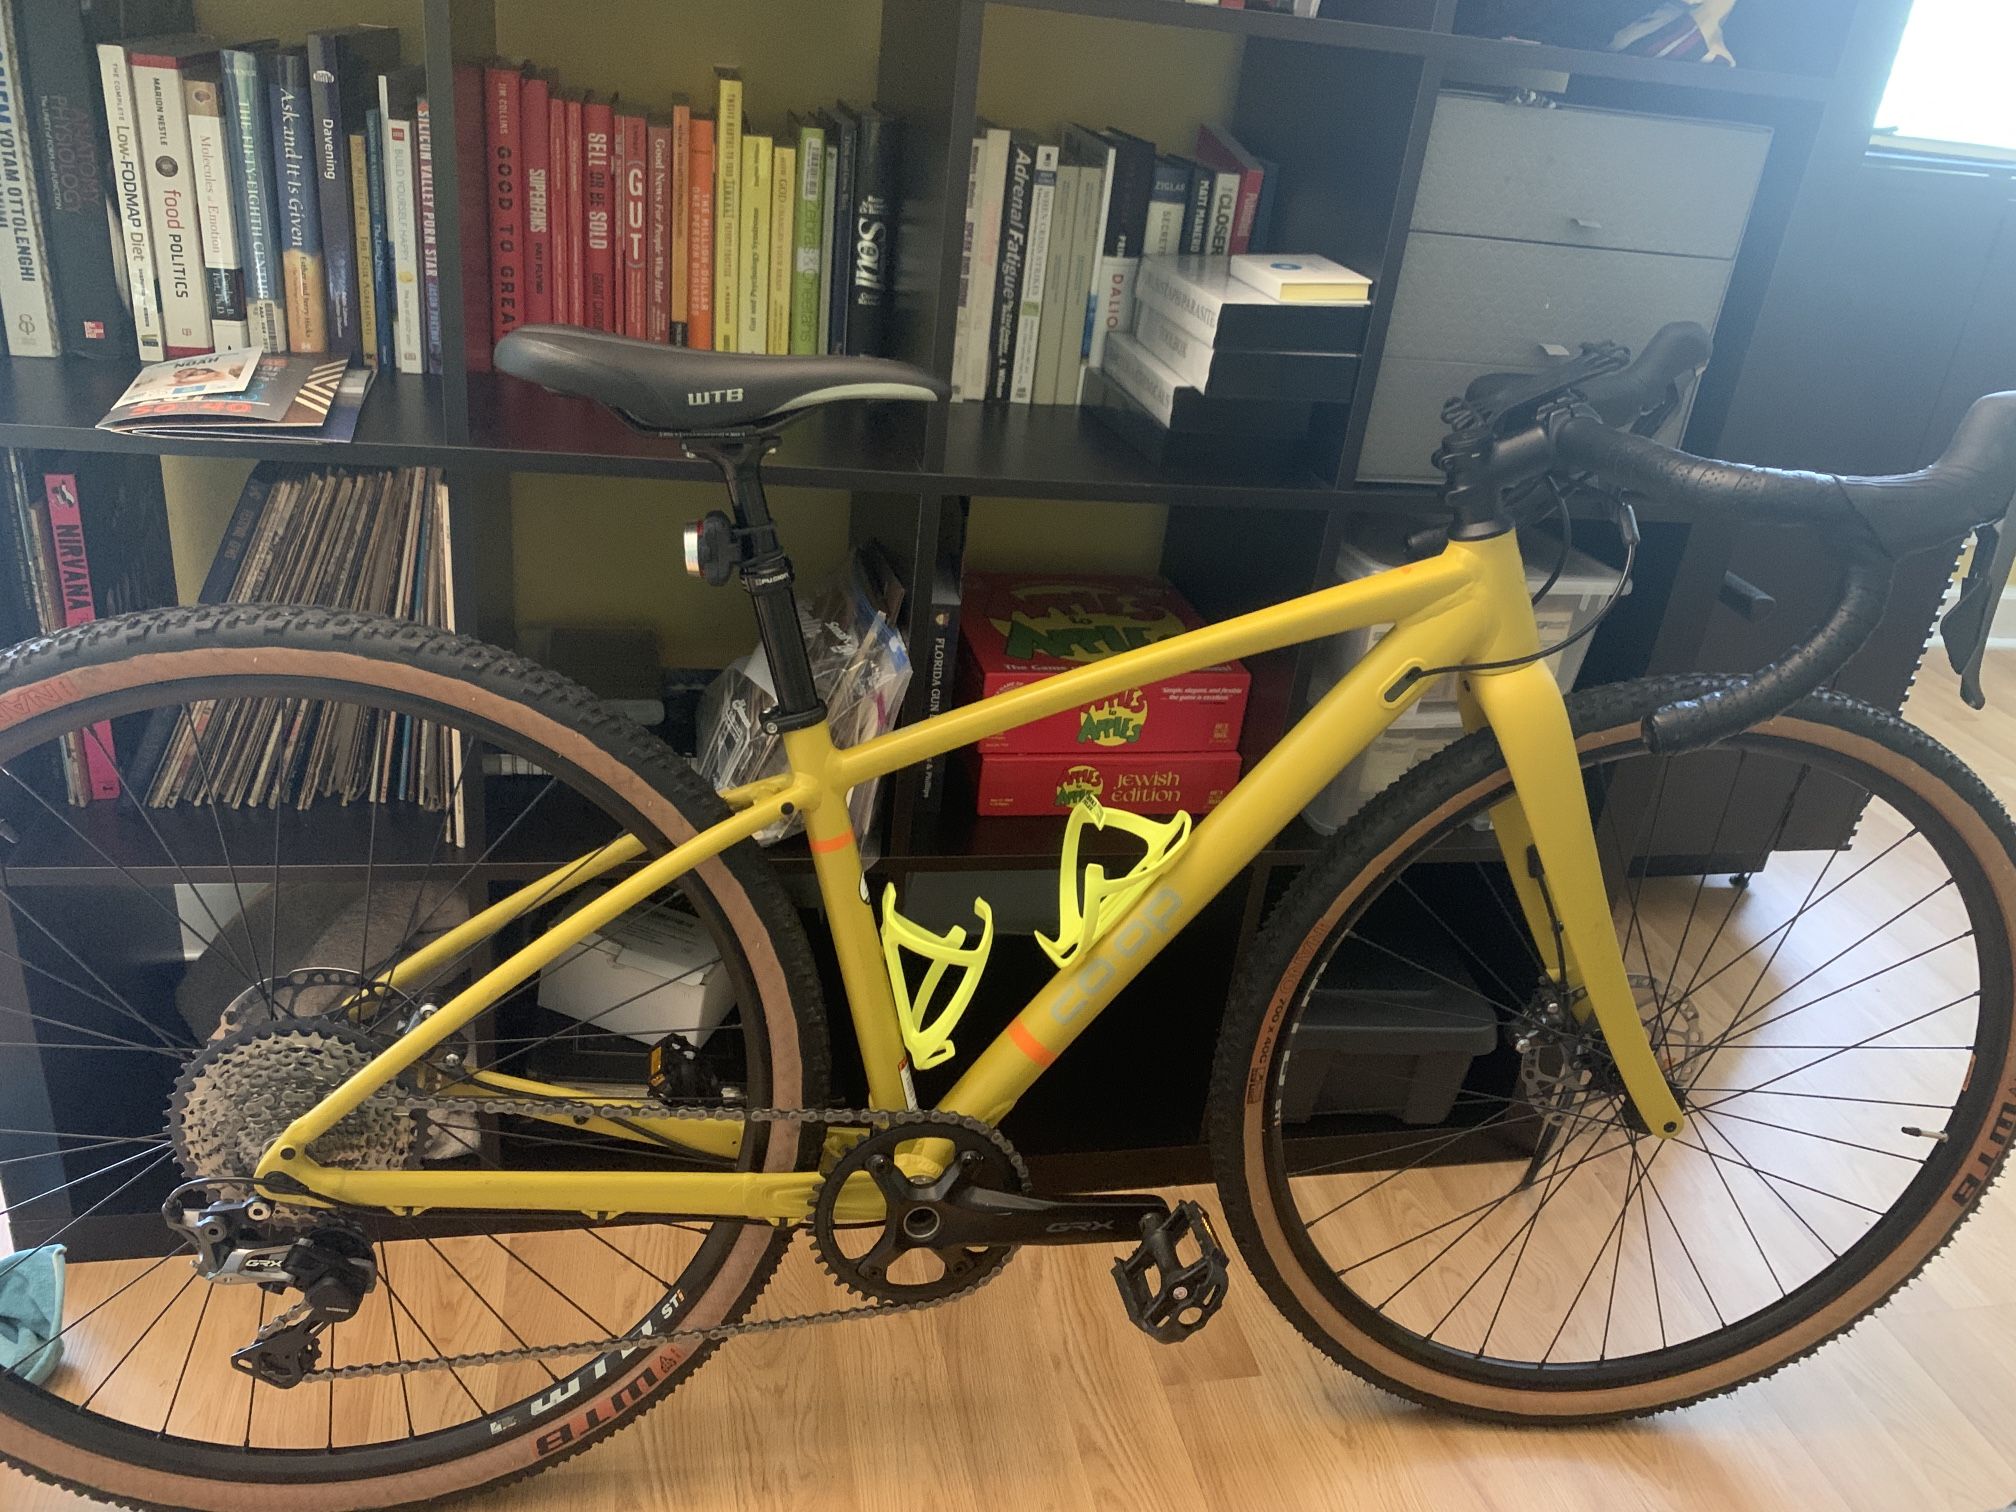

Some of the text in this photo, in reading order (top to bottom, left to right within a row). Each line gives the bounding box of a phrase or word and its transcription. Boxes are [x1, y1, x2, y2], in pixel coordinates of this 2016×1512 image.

[153, 77, 168, 147] MARION NESTLE
[239, 102, 252, 129] THE
[499, 98, 508, 135] COLLINS
[1, 129, 20, 182] YOTAM
[280, 87, 306, 247] Ask and It Is Given
[323, 119, 338, 180] Davening
[497, 145, 514, 210] GOOD
[587, 132, 608, 167] SELL
[654, 138, 666, 169] Good
[200, 135, 222, 254] Molecules Emotion
[242, 135, 263, 237] FIFTY-EIGHTH
[417, 110, 438, 277] SILICON VALLEY PORN STAR
[528, 168, 547, 233] SUPERFANS
[654, 171, 665, 202] News
[778, 178, 788, 204] GOD
[1010, 147, 1032, 230] Adrenal
[1197, 179, 1210, 207] MATT
[7, 187, 36, 282] OTTOLENGHI
[130, 232, 145, 262] Diet
[163, 188, 189, 299] food POLITICS
[500, 223, 514, 253] TO
[588, 210, 608, 250] SOLD
[855, 217, 887, 290] Soul
[253, 241, 269, 300] CENTUR
[1001, 228, 1025, 300] Fatigue
[500, 265, 516, 335] GREA
[1106, 273, 1125, 329] DALIO
[688, 387, 744, 408] WTB
[56, 524, 91, 610] NIRVANA
[929, 637, 946, 713] FLORIDA GUN
[1271, 998, 1286, 1024] 700
[1046, 1219, 1115, 1233] GRX
[245, 1255, 285, 1270] GRX
